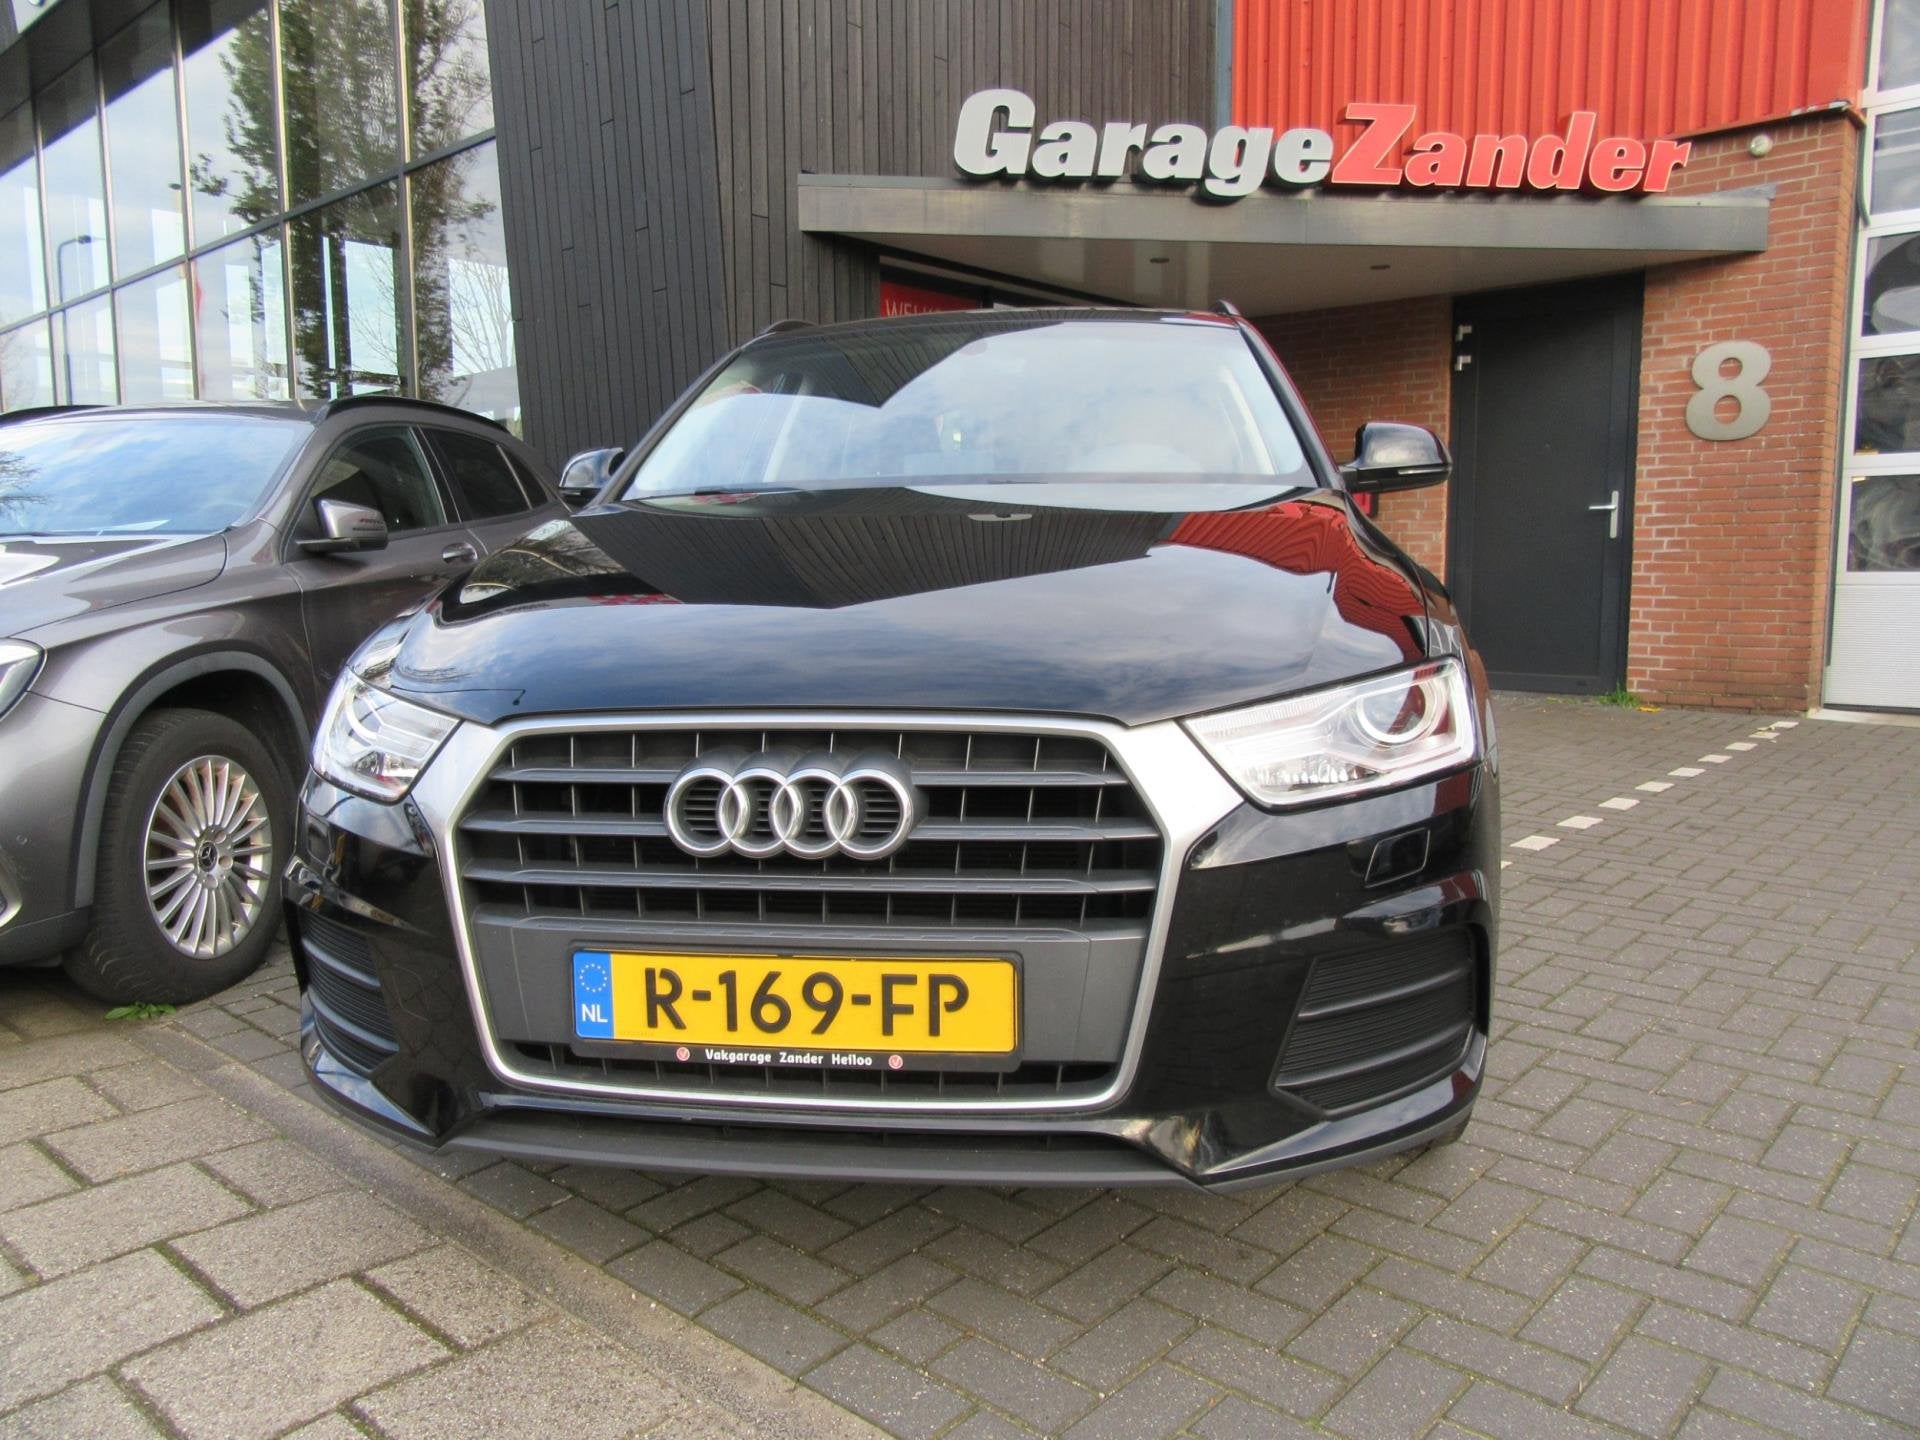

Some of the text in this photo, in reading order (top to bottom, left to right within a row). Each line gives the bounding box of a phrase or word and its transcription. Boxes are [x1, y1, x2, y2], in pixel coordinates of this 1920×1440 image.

[1685, 340, 1772, 441] 8
[581, 1003, 608, 1023] NL
[644, 967, 970, 1037] R-169-FP
[705, 1048, 771, 1064] Vakgarage
[779, 1051, 823, 1065] Zander
[831, 1053, 873, 1066] Heiloo
